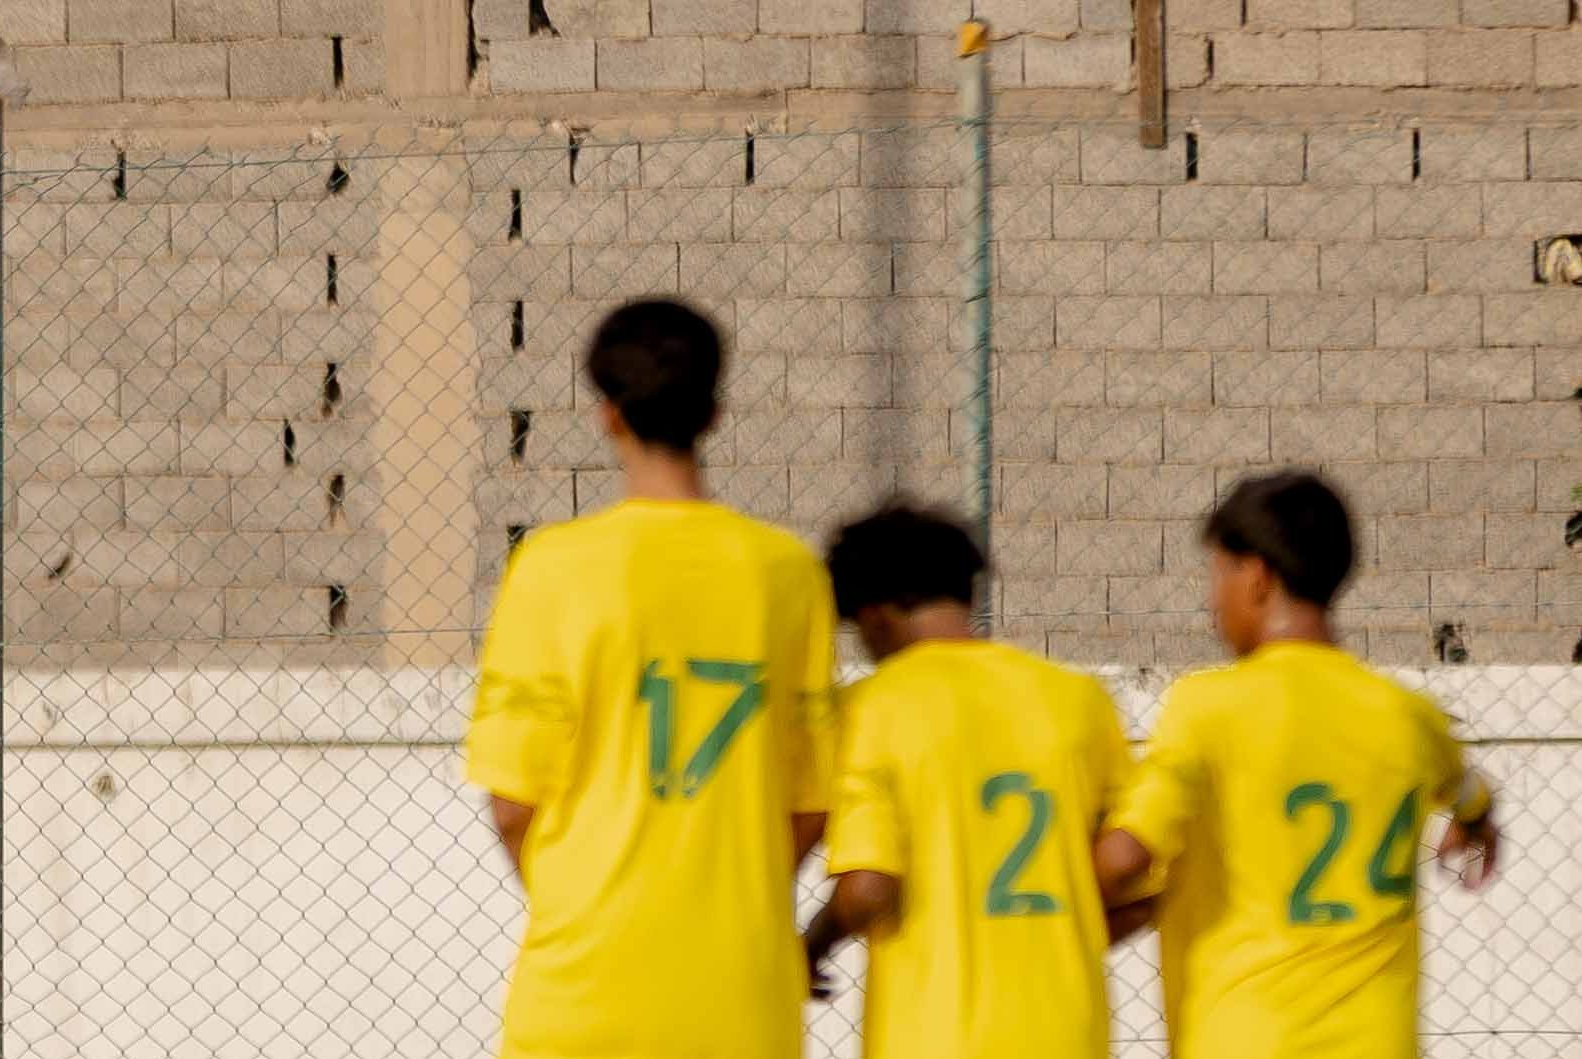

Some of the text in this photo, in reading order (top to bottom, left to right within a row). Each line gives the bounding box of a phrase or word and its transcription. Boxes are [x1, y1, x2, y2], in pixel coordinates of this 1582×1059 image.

[637, 660, 768, 801] 17
[981, 771, 1060, 916] 2
[1285, 781, 1417, 923] 24
